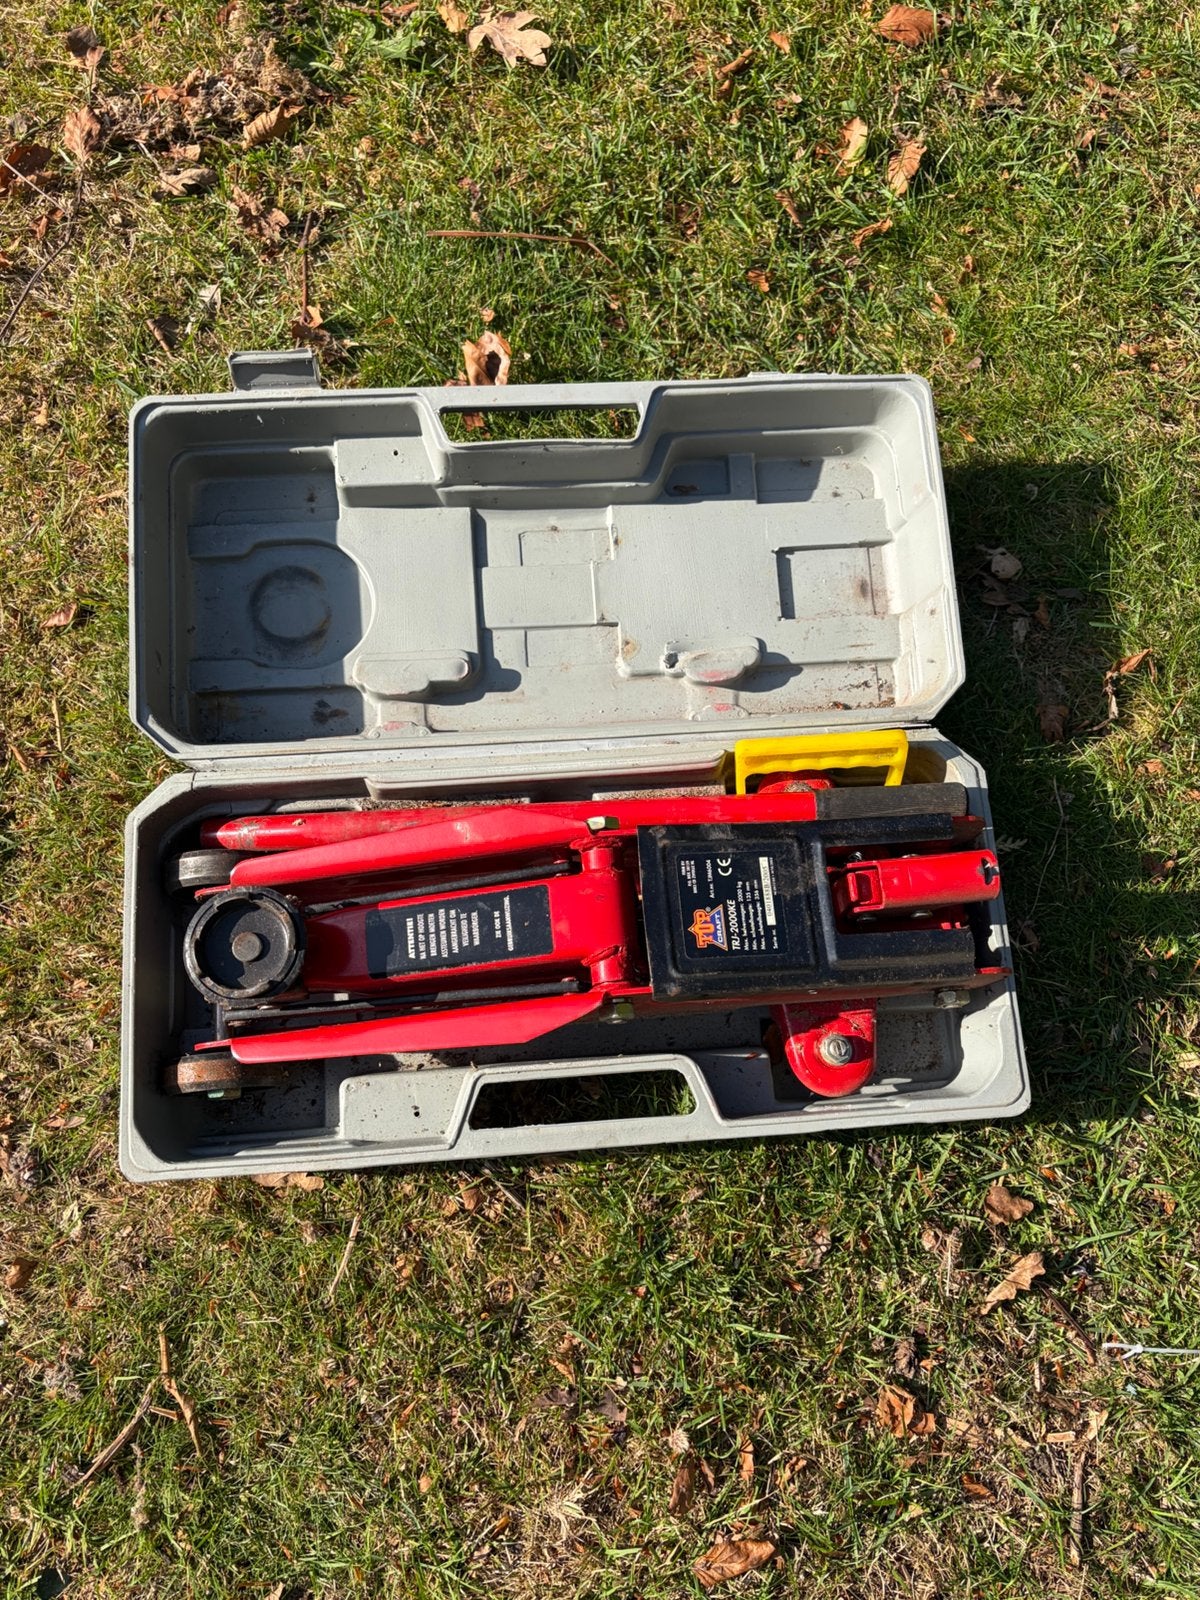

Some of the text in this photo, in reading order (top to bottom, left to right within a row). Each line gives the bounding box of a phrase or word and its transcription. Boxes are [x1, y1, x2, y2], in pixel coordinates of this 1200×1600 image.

[406, 918, 416, 958] ATTENTIE!
[418, 934, 425, 942] OP
[694, 909, 714, 948] TOP
[715, 914, 723, 942] CRAFT
[727, 900, 740, 950] TRJ-2000KE
